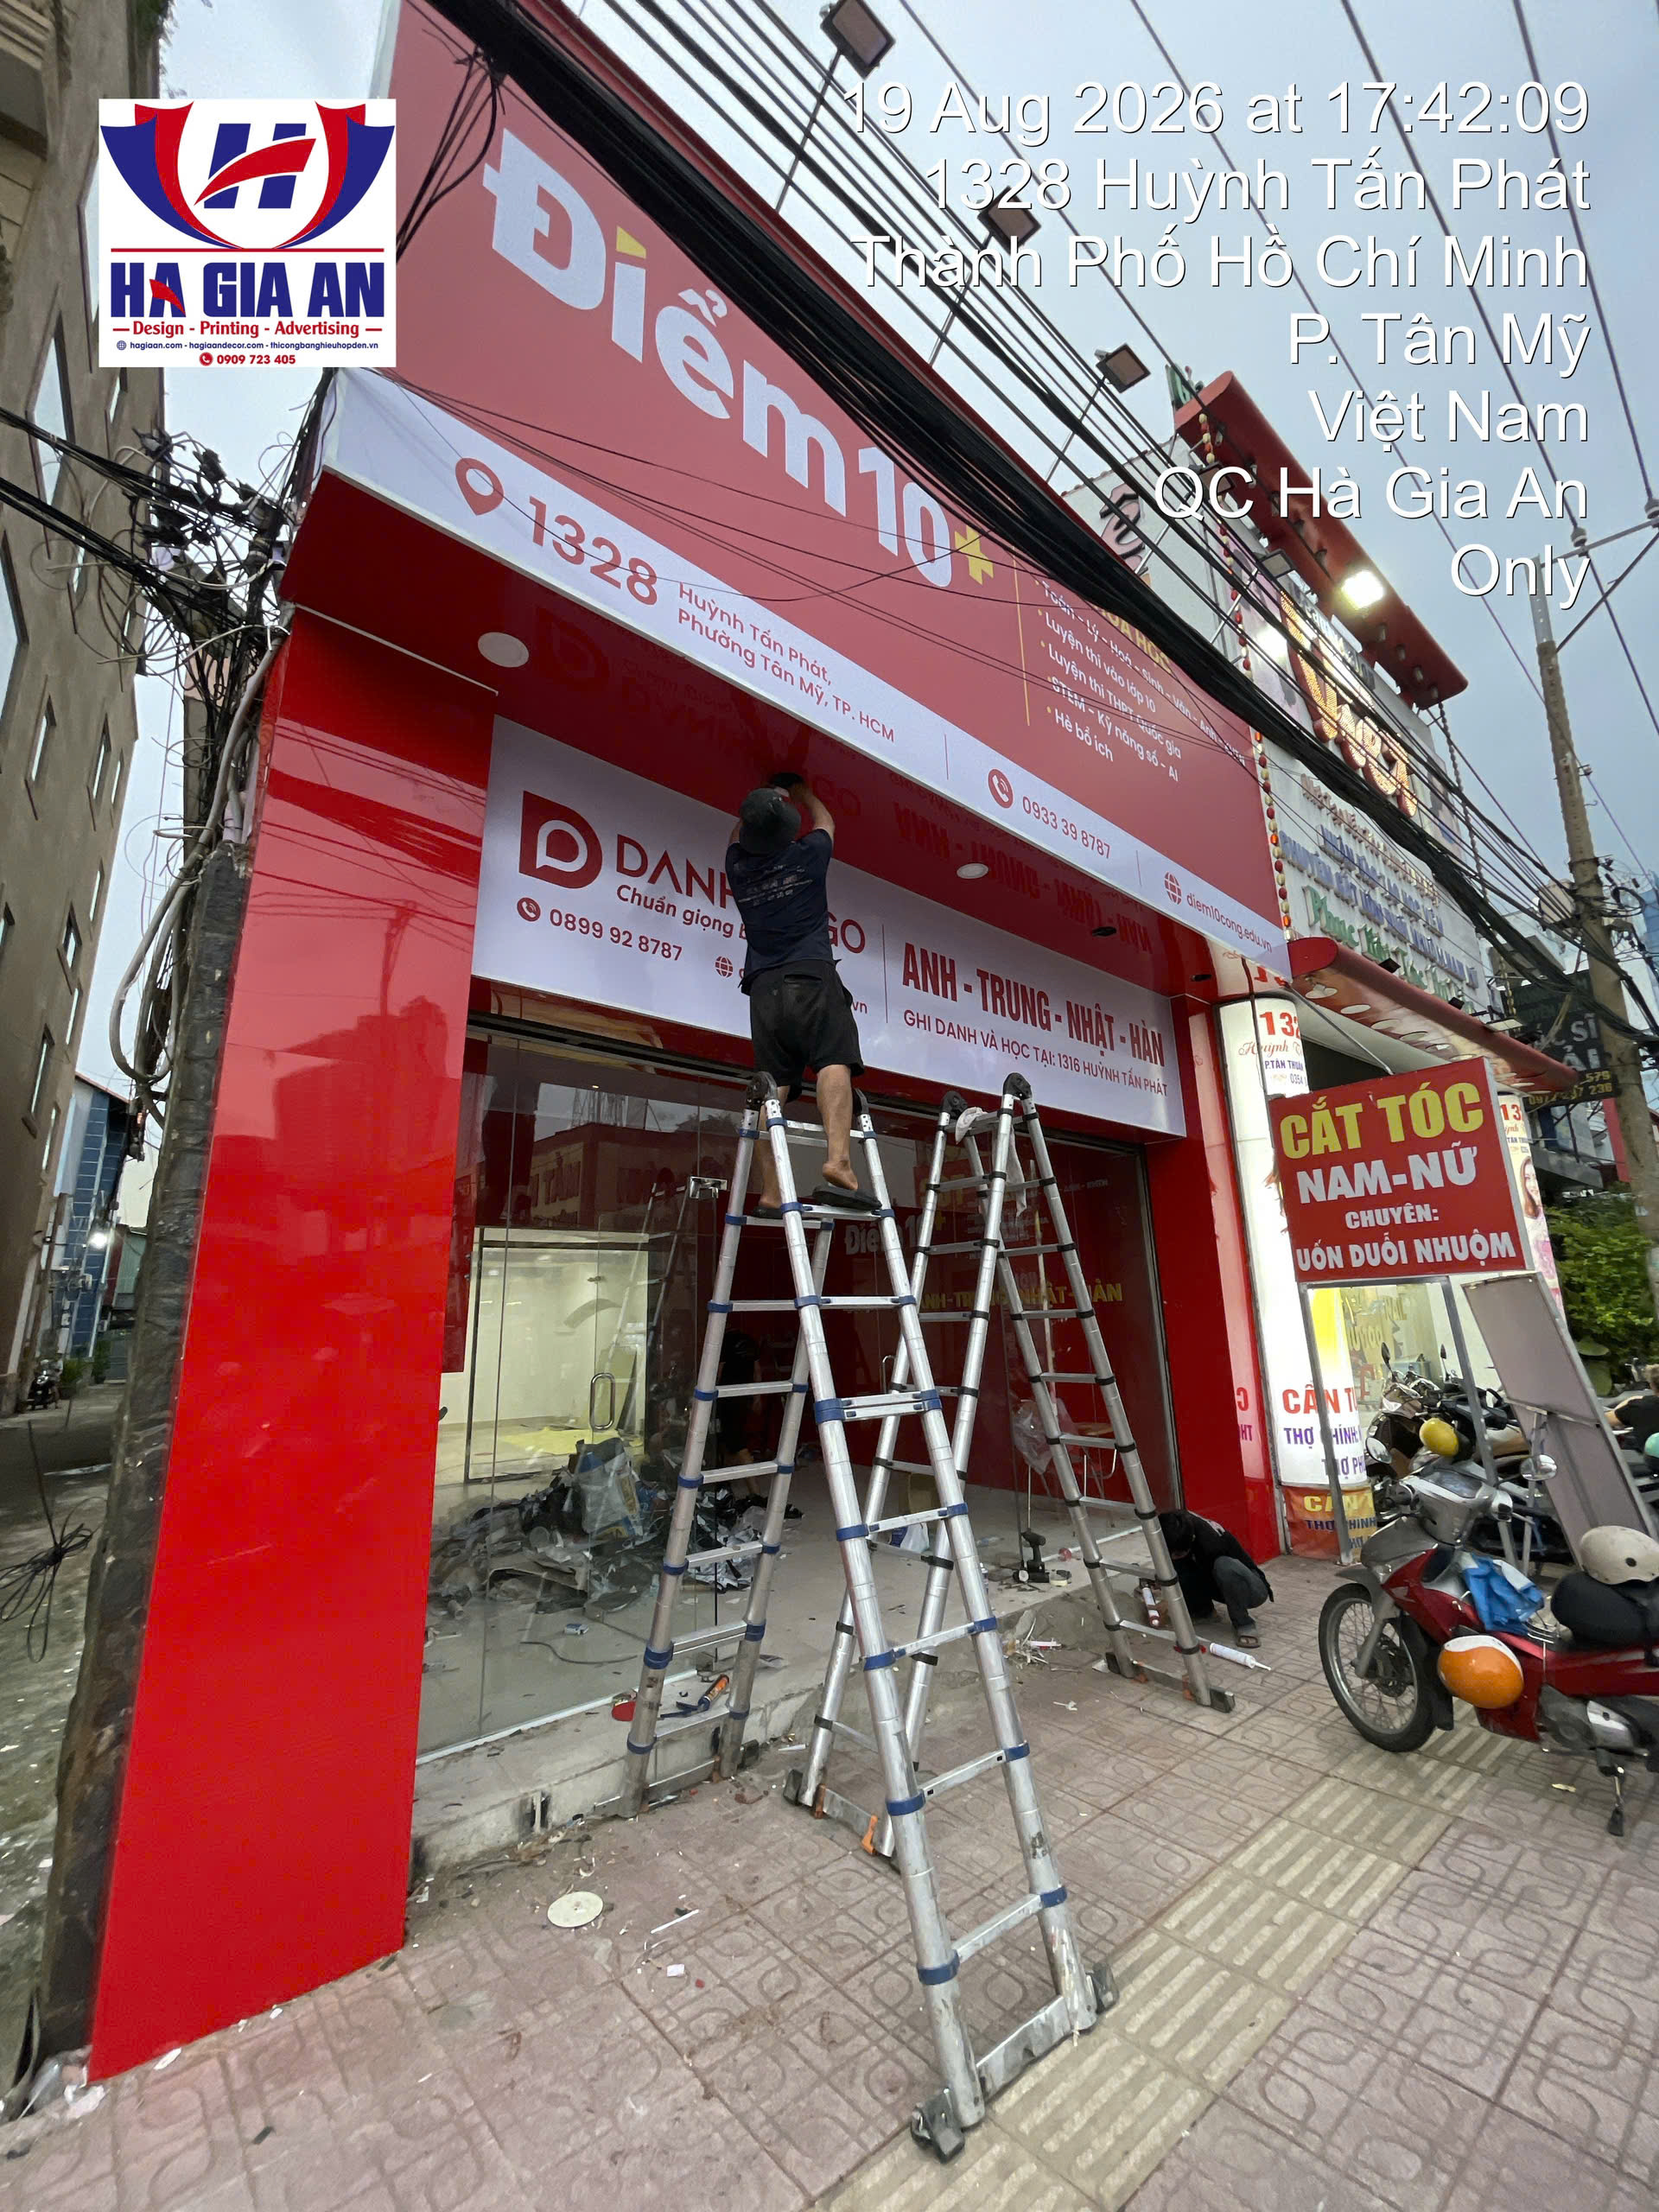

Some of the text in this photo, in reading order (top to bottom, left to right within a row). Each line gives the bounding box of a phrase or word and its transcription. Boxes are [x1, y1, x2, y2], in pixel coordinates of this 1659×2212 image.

[529, 496, 658, 606] 1328
[679, 582, 831, 685] Huỳnh Tấn Phát,
[1046, 612, 1156, 713] Luyện thi vào lớp 10
[678, 610, 894, 742] Phường Tân Mỹ, TP. HCM
[1048, 643, 1087, 684] Luyện
[1089, 676, 1105, 698] thi
[1107, 690, 1134, 721] THPT
[1166, 740, 1181, 760] gia
[1052, 677, 1085, 713] STEM
[1097, 710, 1112, 735] Kỹ
[1115, 726, 1145, 760] năng
[1146, 749, 1159, 766] số
[1055, 708, 1072, 733] Hè
[1075, 721, 1092, 747] bổ
[1023, 795, 1111, 860] 0933 39 8787
[550, 908, 683, 961] 0899 92 8787
[616, 885, 677, 918] Chuẩn
[683, 907, 734, 940] giọng
[1186, 892, 1273, 953] diem10cong.edu.vn
[902, 942, 957, 1002] ANH
[976, 968, 1052, 1032] TRUNG
[1066, 1000, 1115, 1056] NHẬT
[1128, 1019, 1165, 1067] HÀN
[904, 1009, 1168, 1097] GHI DANH VÀ HỌC TẠI: 1316 HUỲNH TẤN PHÁT
[1281, 1094, 1363, 1160] CẮT
[1376, 1081, 1484, 1143] TÓC
[1297, 1140, 1478, 1205] NAM-NỮ
[1296, 1229, 1516, 1272] UỐN DUỖI NHUỘM
[1345, 1202, 1440, 1230] CHUYÊN:
[1283, 1426, 1314, 1450] THỢ
